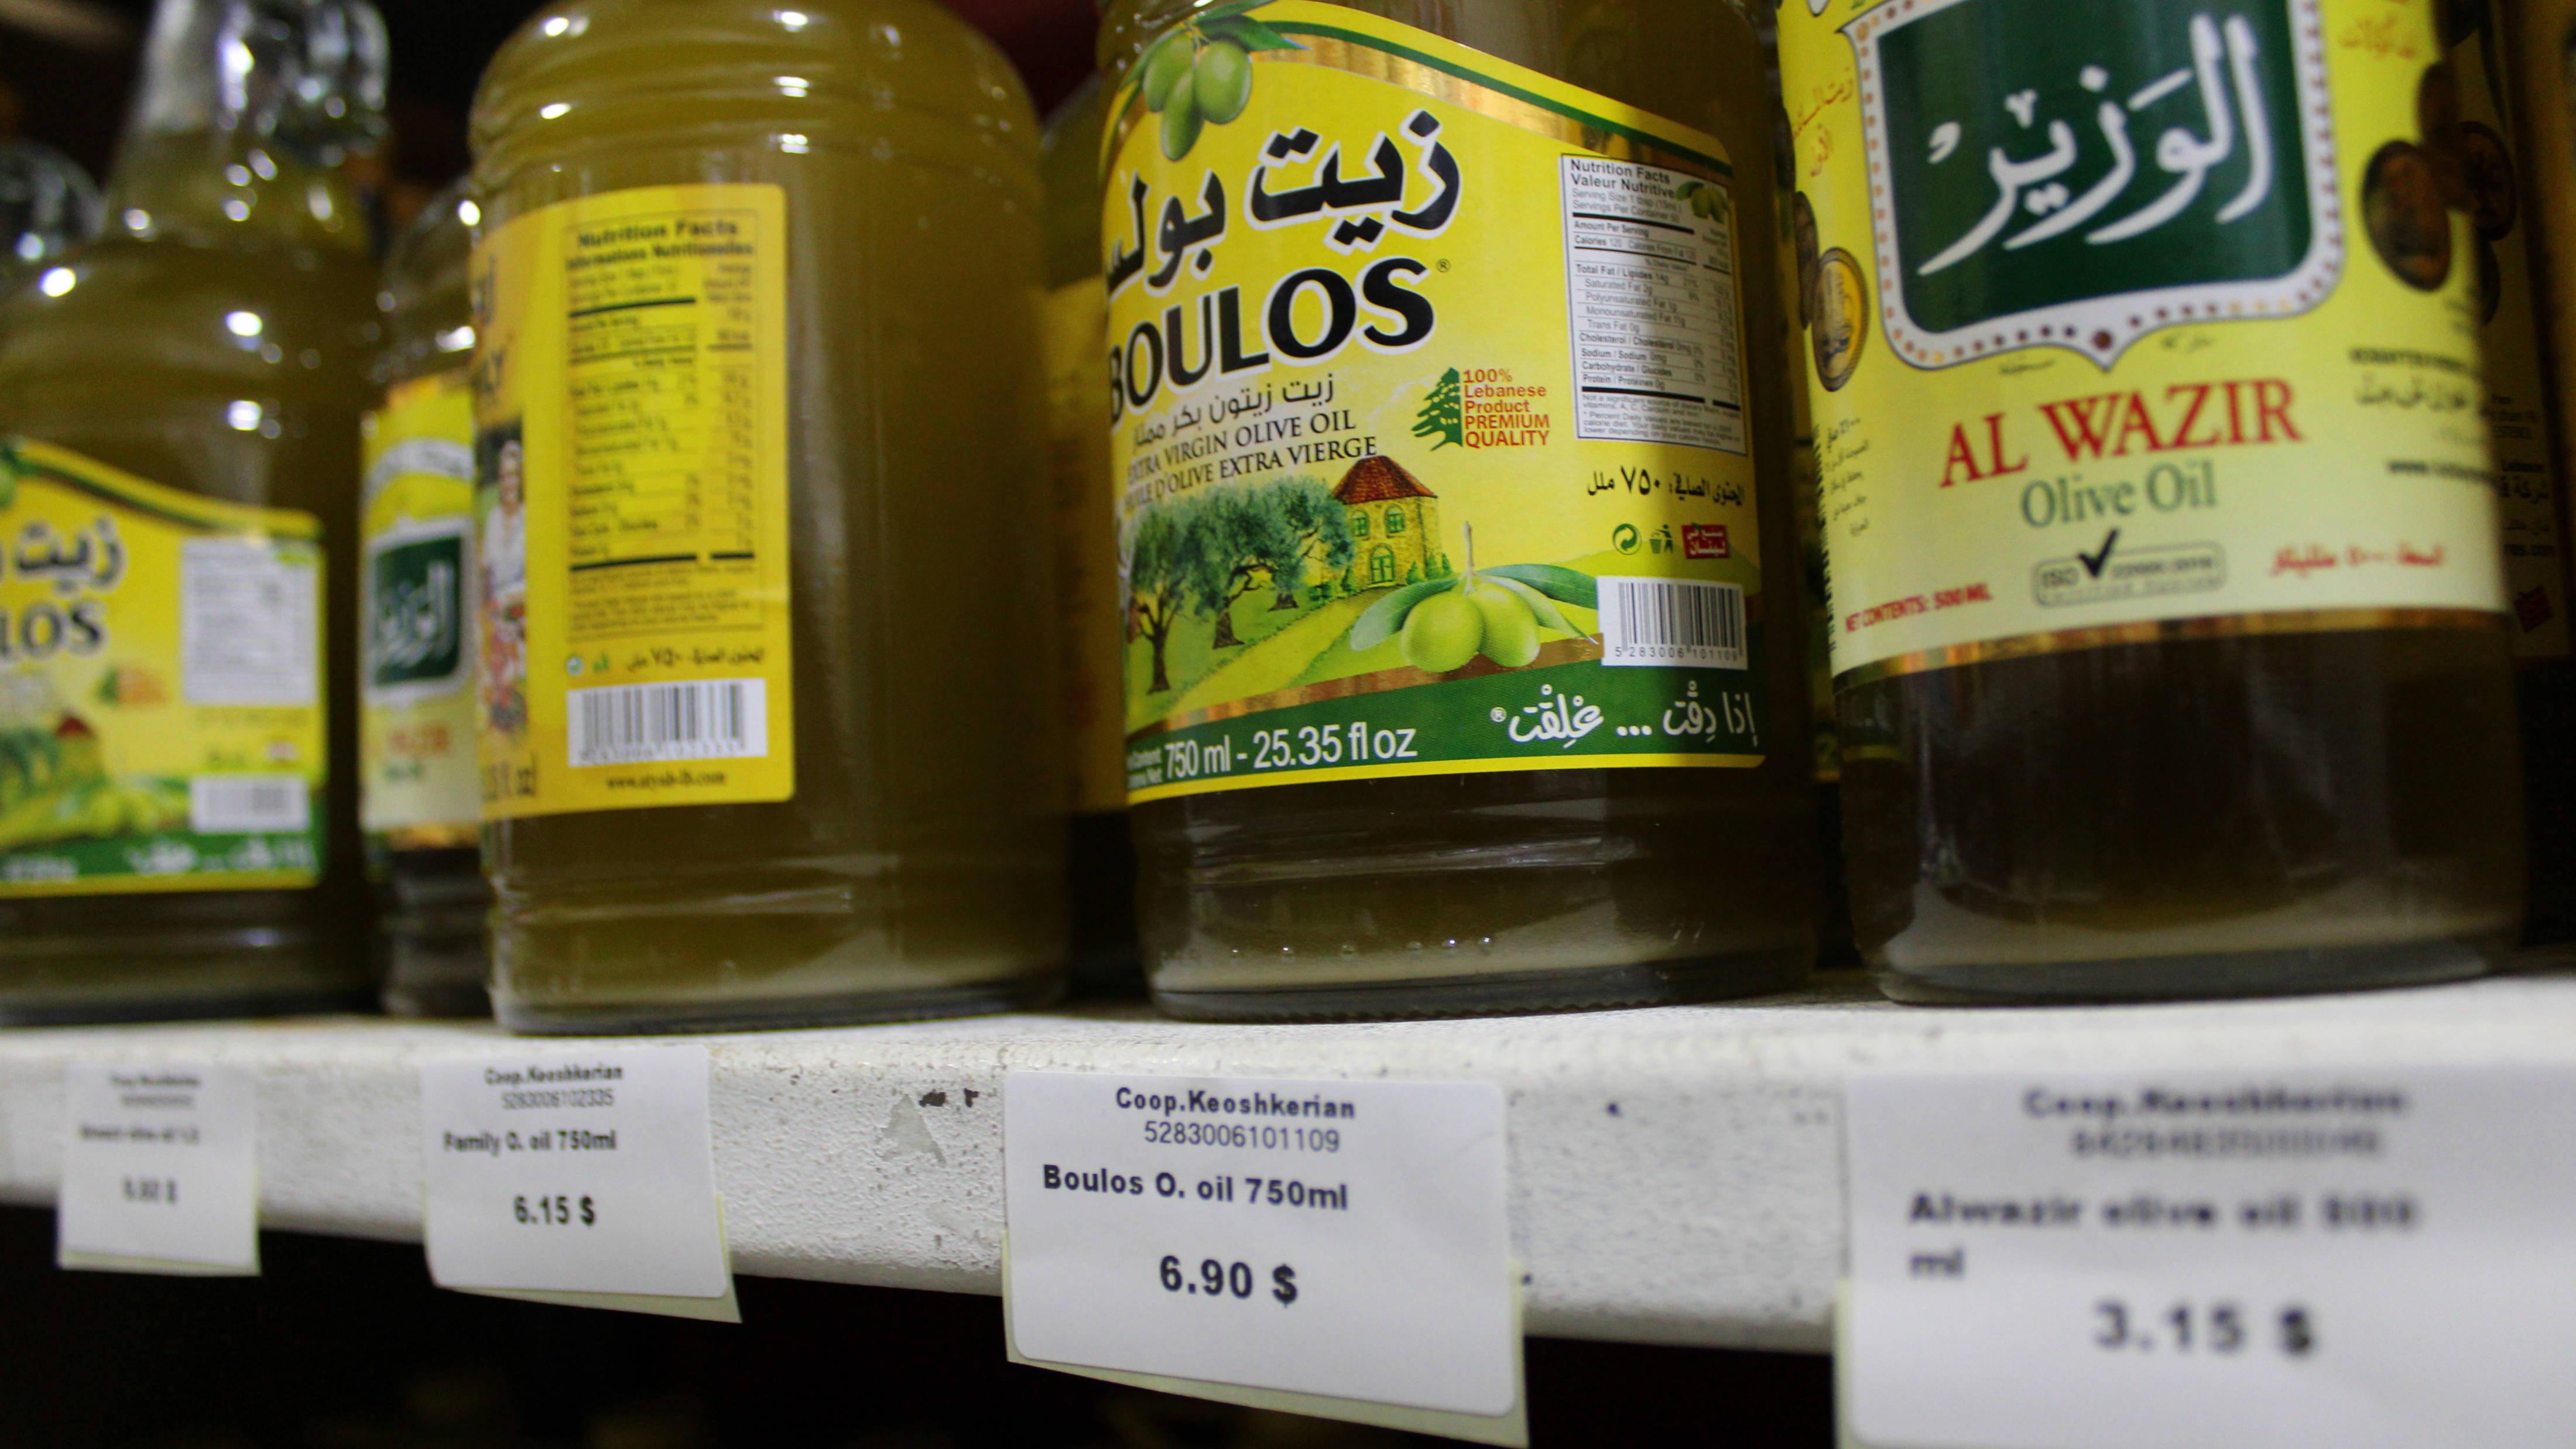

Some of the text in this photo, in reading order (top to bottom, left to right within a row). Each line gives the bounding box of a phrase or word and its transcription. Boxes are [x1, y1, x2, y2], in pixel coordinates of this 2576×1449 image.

[1251, 109, 1461, 246] زيت
[1571, 159, 1670, 183] Nutrition Facts
[1571, 173, 1674, 198] Valeur Nutritive
[1573, 188, 1606, 202] Serving
[1609, 192, 1627, 202] Size
[1573, 200, 1612, 214] Servings
[1614, 204, 1628, 213] Per
[577, 217, 739, 248] Nutrition Facts
[1574, 221, 1650, 239] Amount Per Serving
[1574, 235, 1607, 246] Calories
[1575, 263, 1598, 273] Total
[1600, 265, 1616, 275] Fat
[1584, 278, 1626, 290] Saturated
[1628, 281, 1641, 292] Fat
[1585, 291, 1652, 307] Polyunsaturated
[1586, 305, 1657, 321] Monounsaturated
[1587, 319, 1612, 330] Trans
[1614, 320, 1628, 331] Fat
[1111, 256, 1435, 425] BOULOS
[1580, 333, 1626, 344] Cholesterol
[1581, 348, 1612, 358] Sodium
[1618, 350, 1647, 361] Sodium
[1464, 368, 1513, 383] 100%
[1582, 361, 1673, 377] Carbohydrate Glucides
[1582, 374, 1612, 384] Protein
[1282, 372, 1333, 407] زيت
[1465, 384, 1547, 398] Lebanese
[1209, 382, 1272, 424] زيتون
[1465, 399, 1530, 415] Product
[1589, 411, 1621, 420] Percent
[1173, 405, 1201, 437] بكر
[1465, 413, 1550, 430] PREMIUM
[1939, 413, 2029, 488] AL
[2039, 378, 2306, 463] WAZIR
[1164, 430, 1228, 466] VIRGIN
[1235, 416, 1302, 447] OLIVE
[1310, 409, 1356, 434] OIL
[1465, 429, 1550, 448] QUALITY
[1219, 449, 1283, 479] EXTRA
[1287, 436, 1377, 465] VIERGE
[1587, 471, 1615, 496] ملل
[1621, 465, 1661, 495] ٧٥٠
[2020, 458, 2217, 527] Olive Oil
[1615, 646, 1739, 662] 5 283006 101109
[1722, 691, 1758, 747] إذا
[1164, 739, 1199, 779] 750
[1203, 734, 1231, 775] ml
[1236, 751, 1248, 761] -
[1253, 724, 1342, 770] 25.35
[1348, 721, 1369, 761] fl
[1373, 728, 1419, 760] oz
[484, 1063, 624, 1087] Coop.Keoshkerian
[1115, 1087, 1356, 1121] Coop.Keoshkerian
[443, 1129, 617, 1157] Family O. oil 750ml
[1143, 1120, 1341, 1153] 5283006101109
[1042, 1163, 1348, 1211] Boulos O. oil 750ml
[513, 1195, 597, 1228] 6.15 $
[1909, 1193, 2083, 1228] Alwazir
[2101, 1196, 2219, 1230] olive
[1909, 1248, 1966, 1279] ml
[1159, 1255, 1299, 1308] 6.90 $
[2094, 1301, 2317, 1359] 3.15 $
